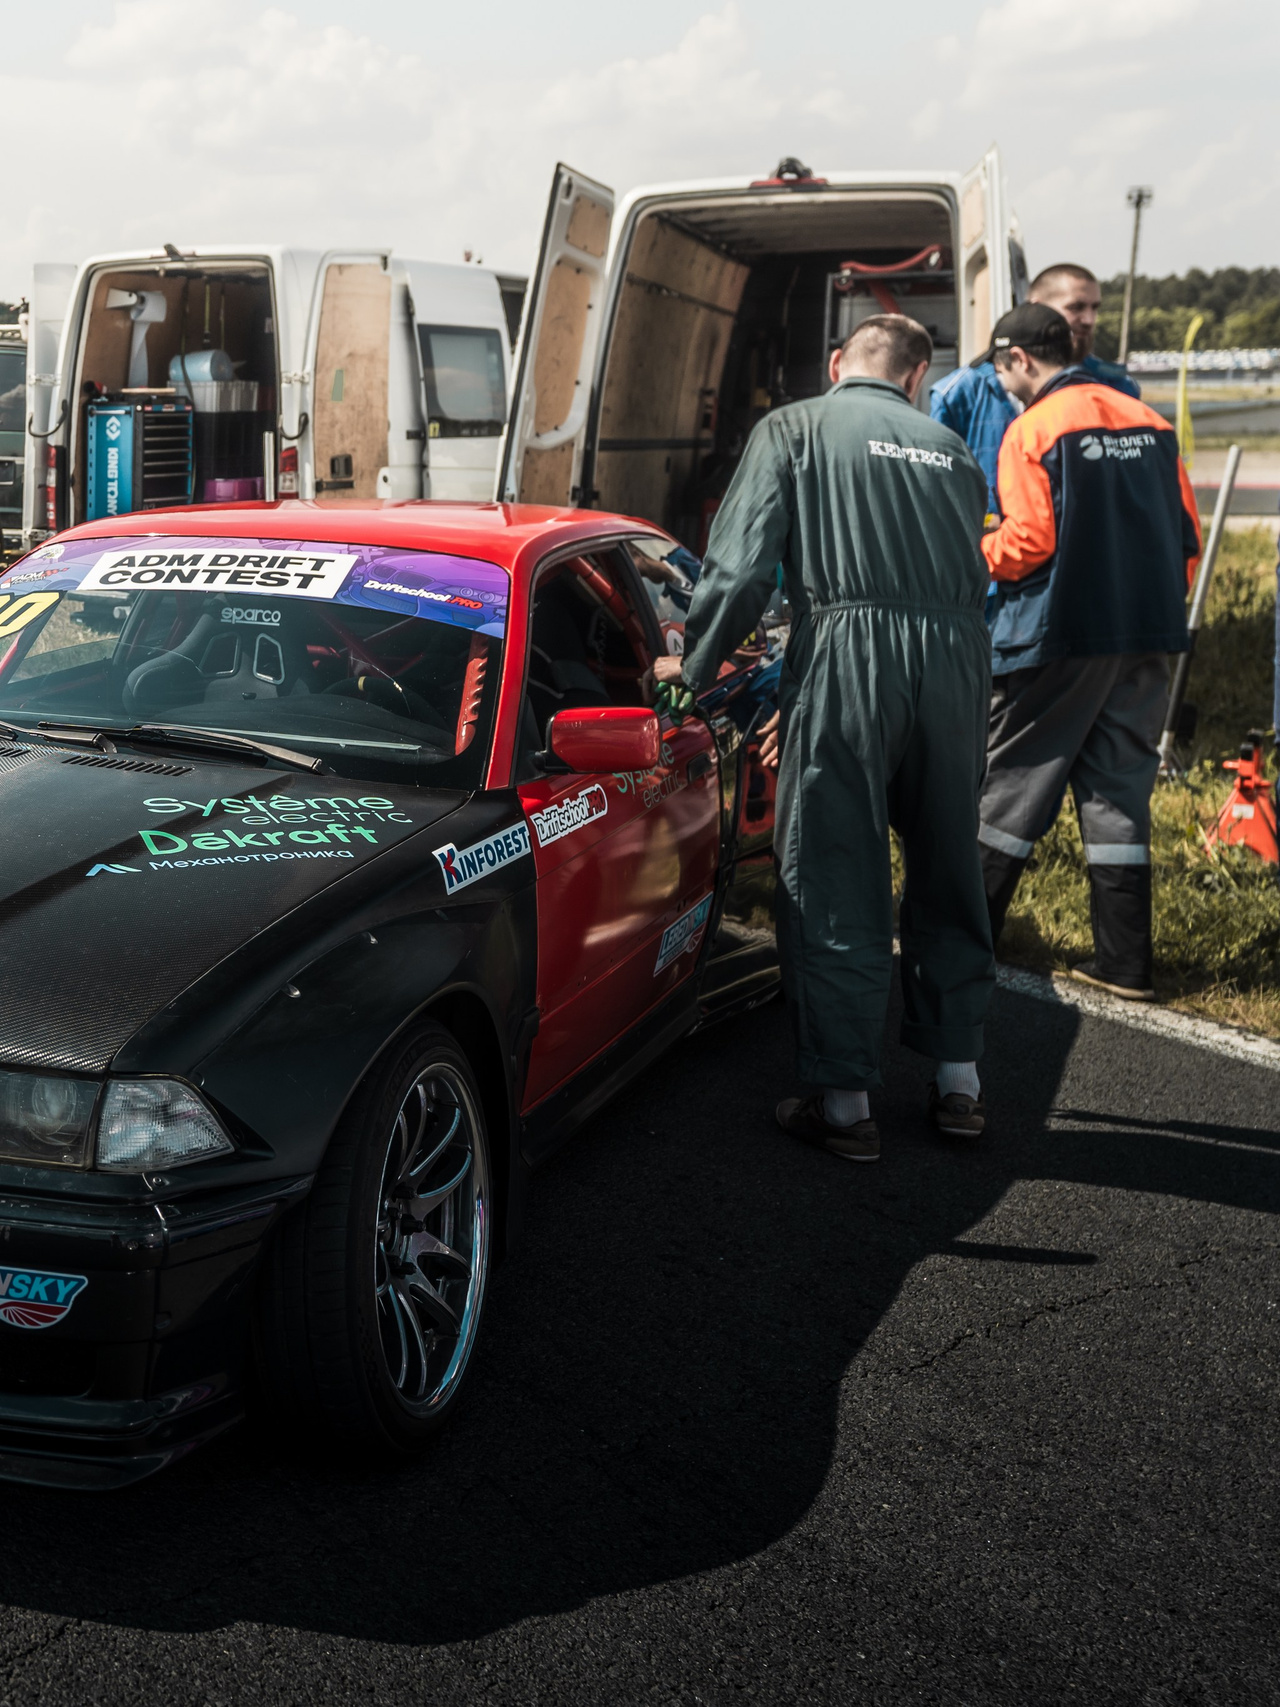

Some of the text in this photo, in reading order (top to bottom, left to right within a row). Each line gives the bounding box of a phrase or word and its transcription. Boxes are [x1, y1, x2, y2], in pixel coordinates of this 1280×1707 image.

[867, 440, 954, 472] KENTECH
[107, 447, 119, 516] KING TONY
[110, 554, 335, 572] ADM DRIFT
[99, 568, 326, 590] CONTEST
[221, 607, 281, 625] sparco
[142, 794, 395, 817] Systême
[241, 809, 414, 826] electric
[138, 824, 380, 856] Dēkraft
[148, 848, 355, 871] Механотроника
[438, 825, 531, 889] KINFOREST
